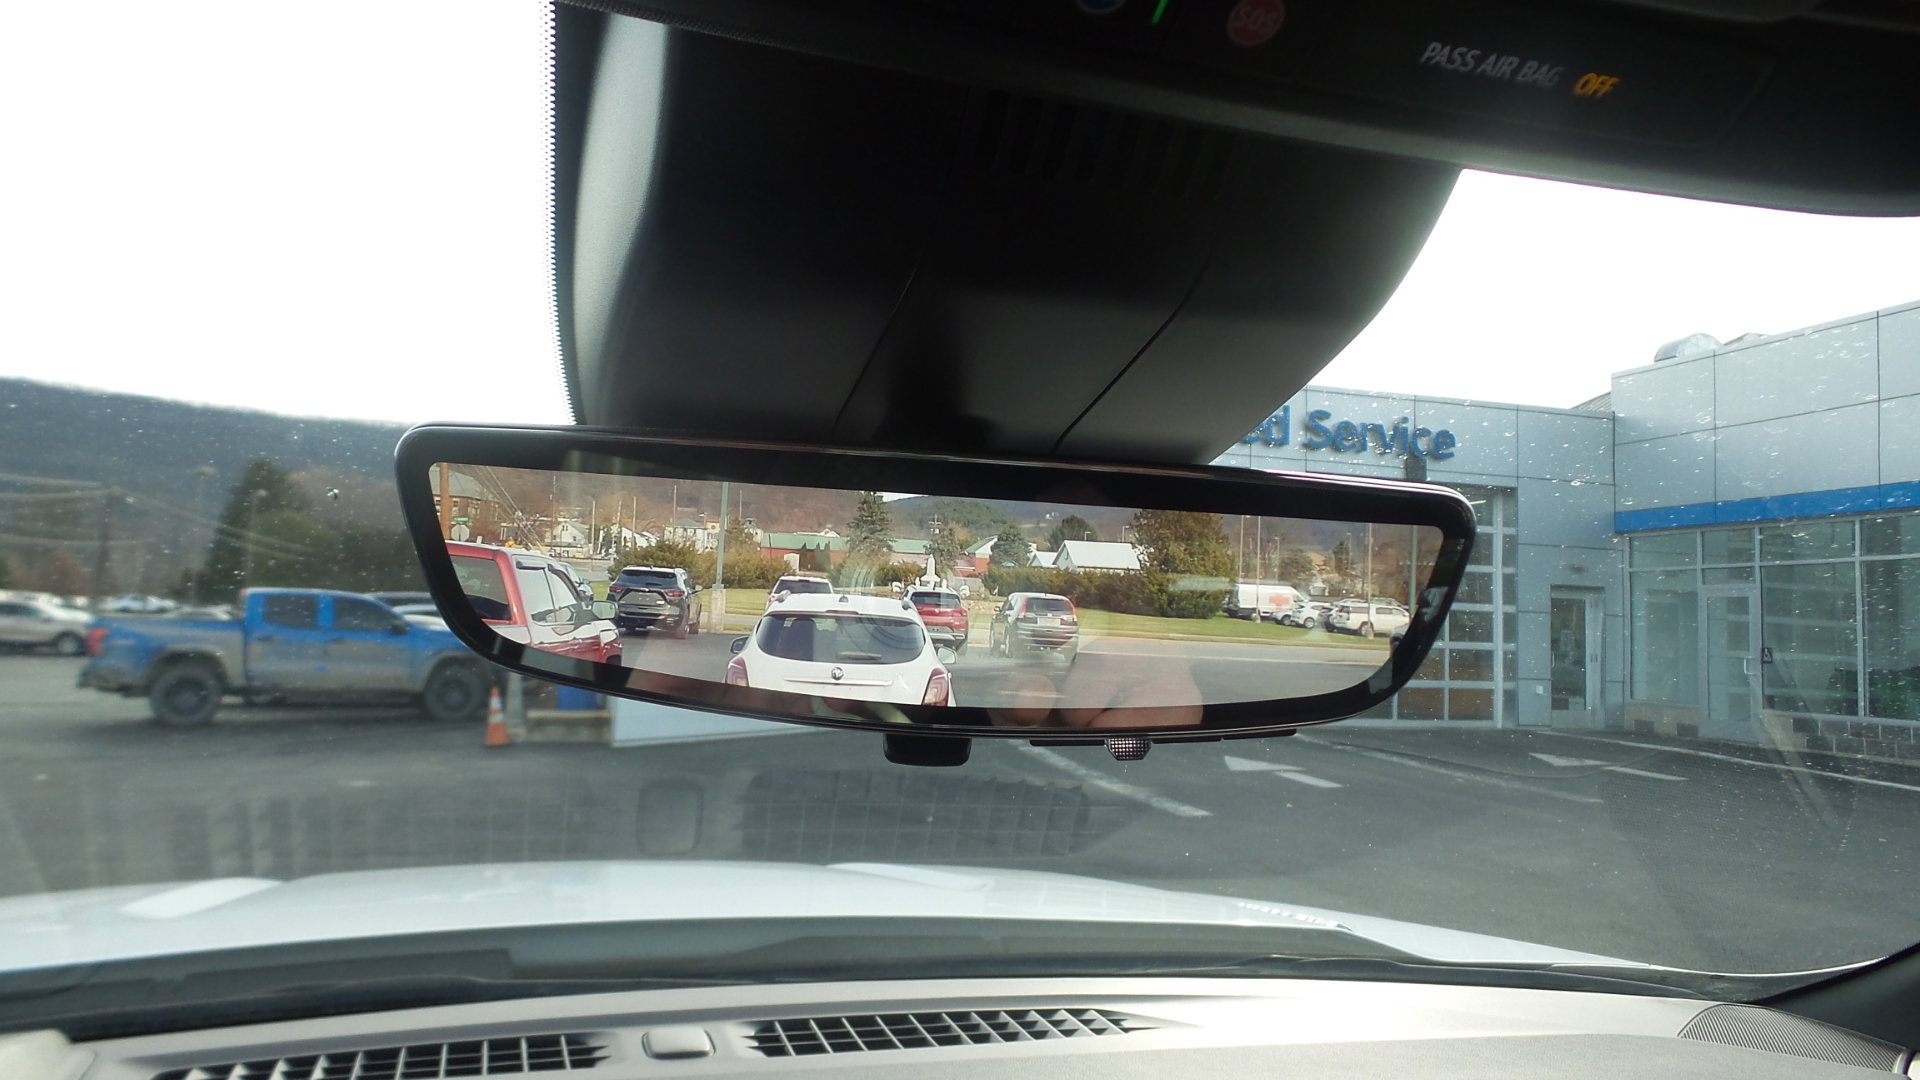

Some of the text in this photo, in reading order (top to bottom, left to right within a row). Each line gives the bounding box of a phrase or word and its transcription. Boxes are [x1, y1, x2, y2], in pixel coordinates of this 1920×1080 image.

[1231, 5, 1278, 31] SOS
[1419, 42, 1620, 97] PASS AIR BAG OFF
[1306, 409, 1456, 459] Service
